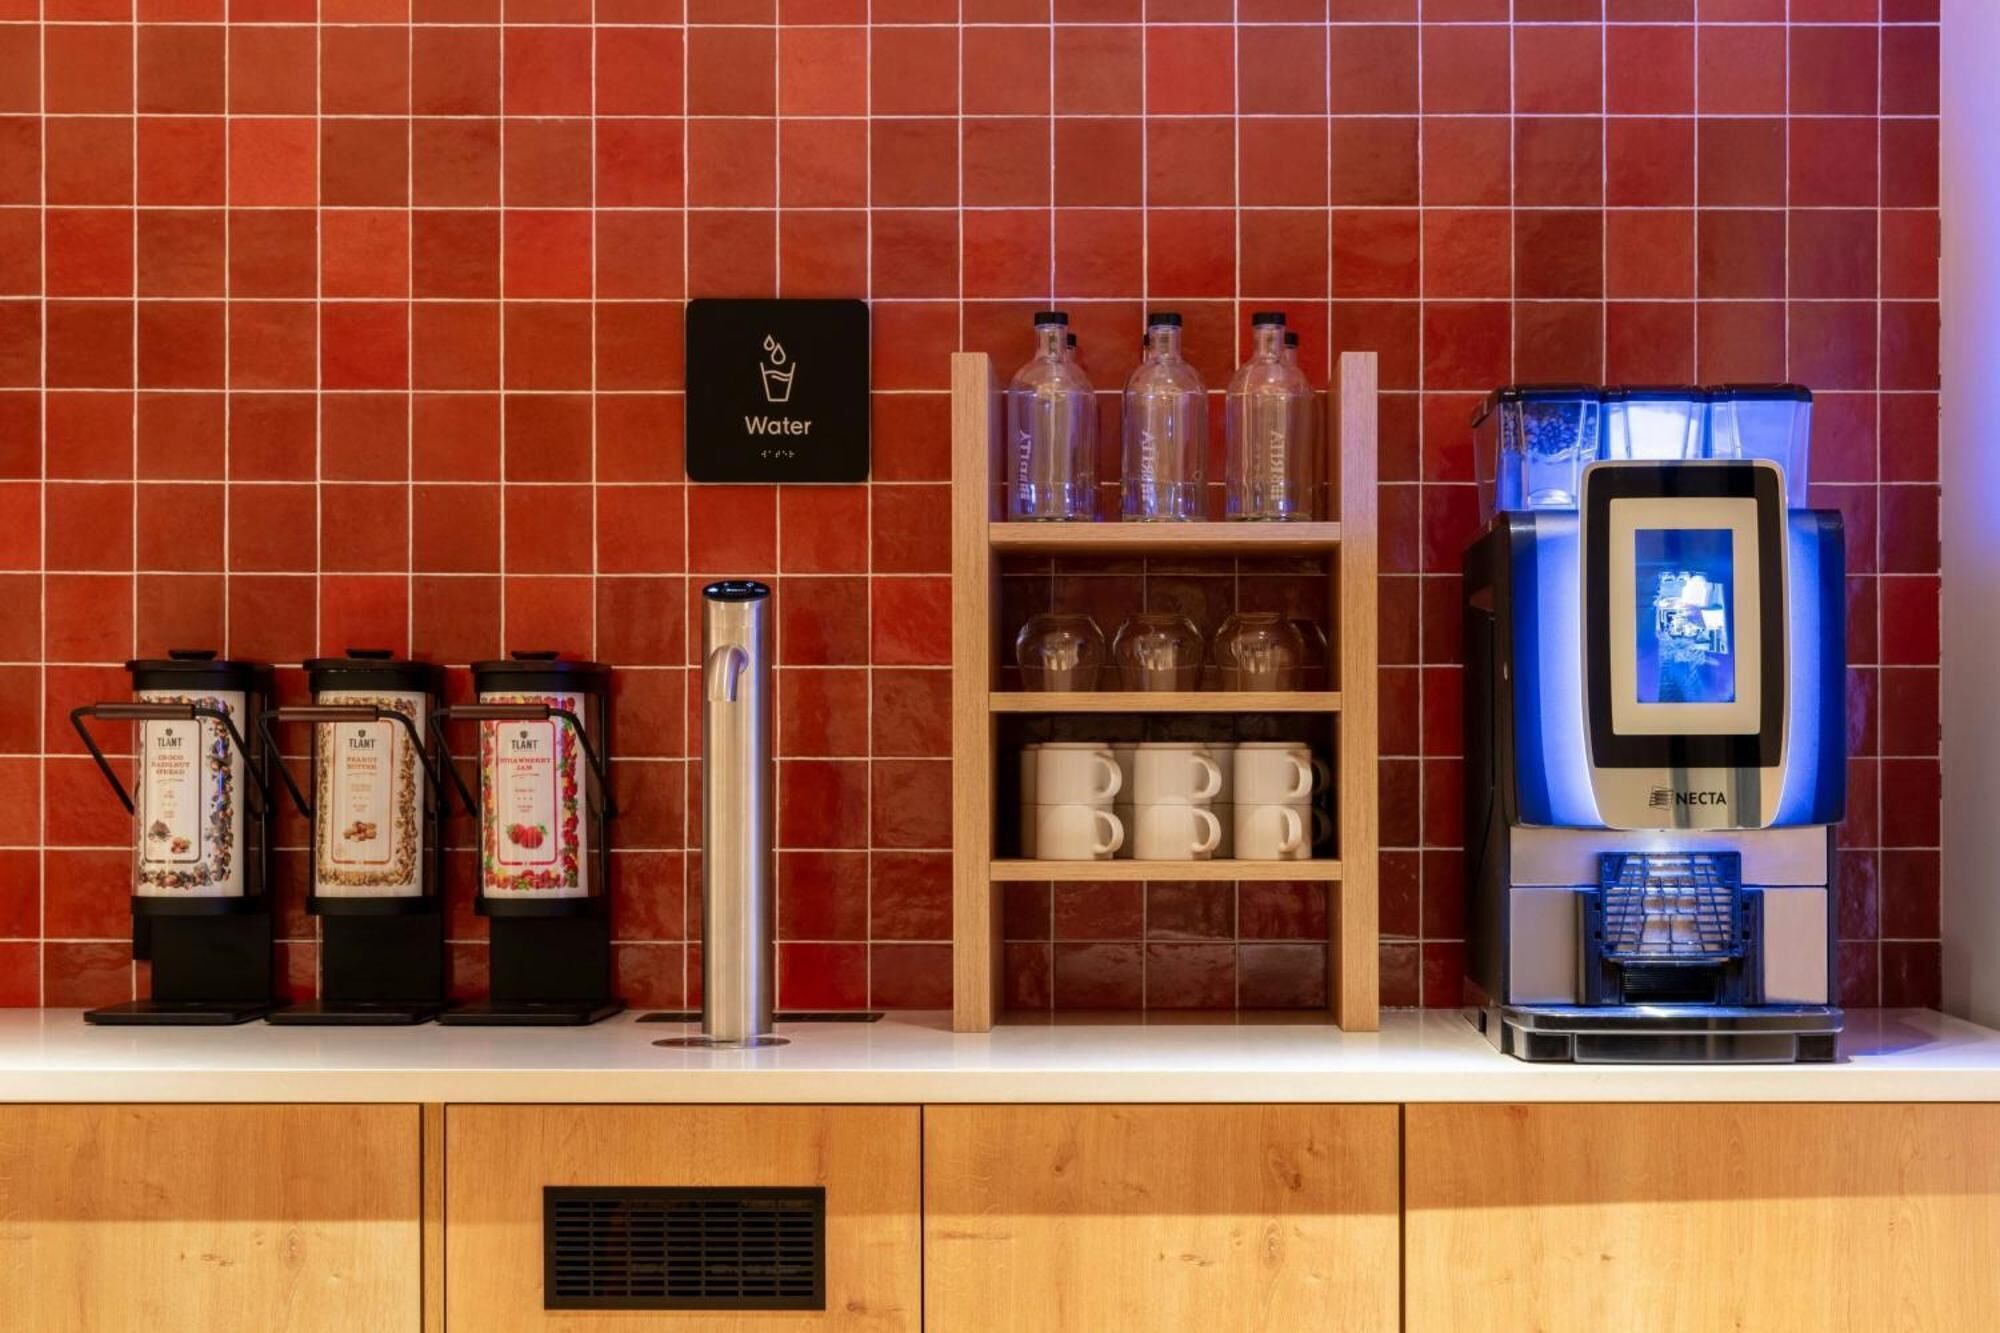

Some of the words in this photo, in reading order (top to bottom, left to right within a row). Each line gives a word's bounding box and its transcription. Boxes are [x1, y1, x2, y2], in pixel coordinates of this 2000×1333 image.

[745, 416, 811, 435] Water
[157, 737, 183, 747] TLANT
[349, 738, 375, 748] TLANT
[511, 740, 538, 750] TLANT
[1676, 792, 1727, 805] NECTA
